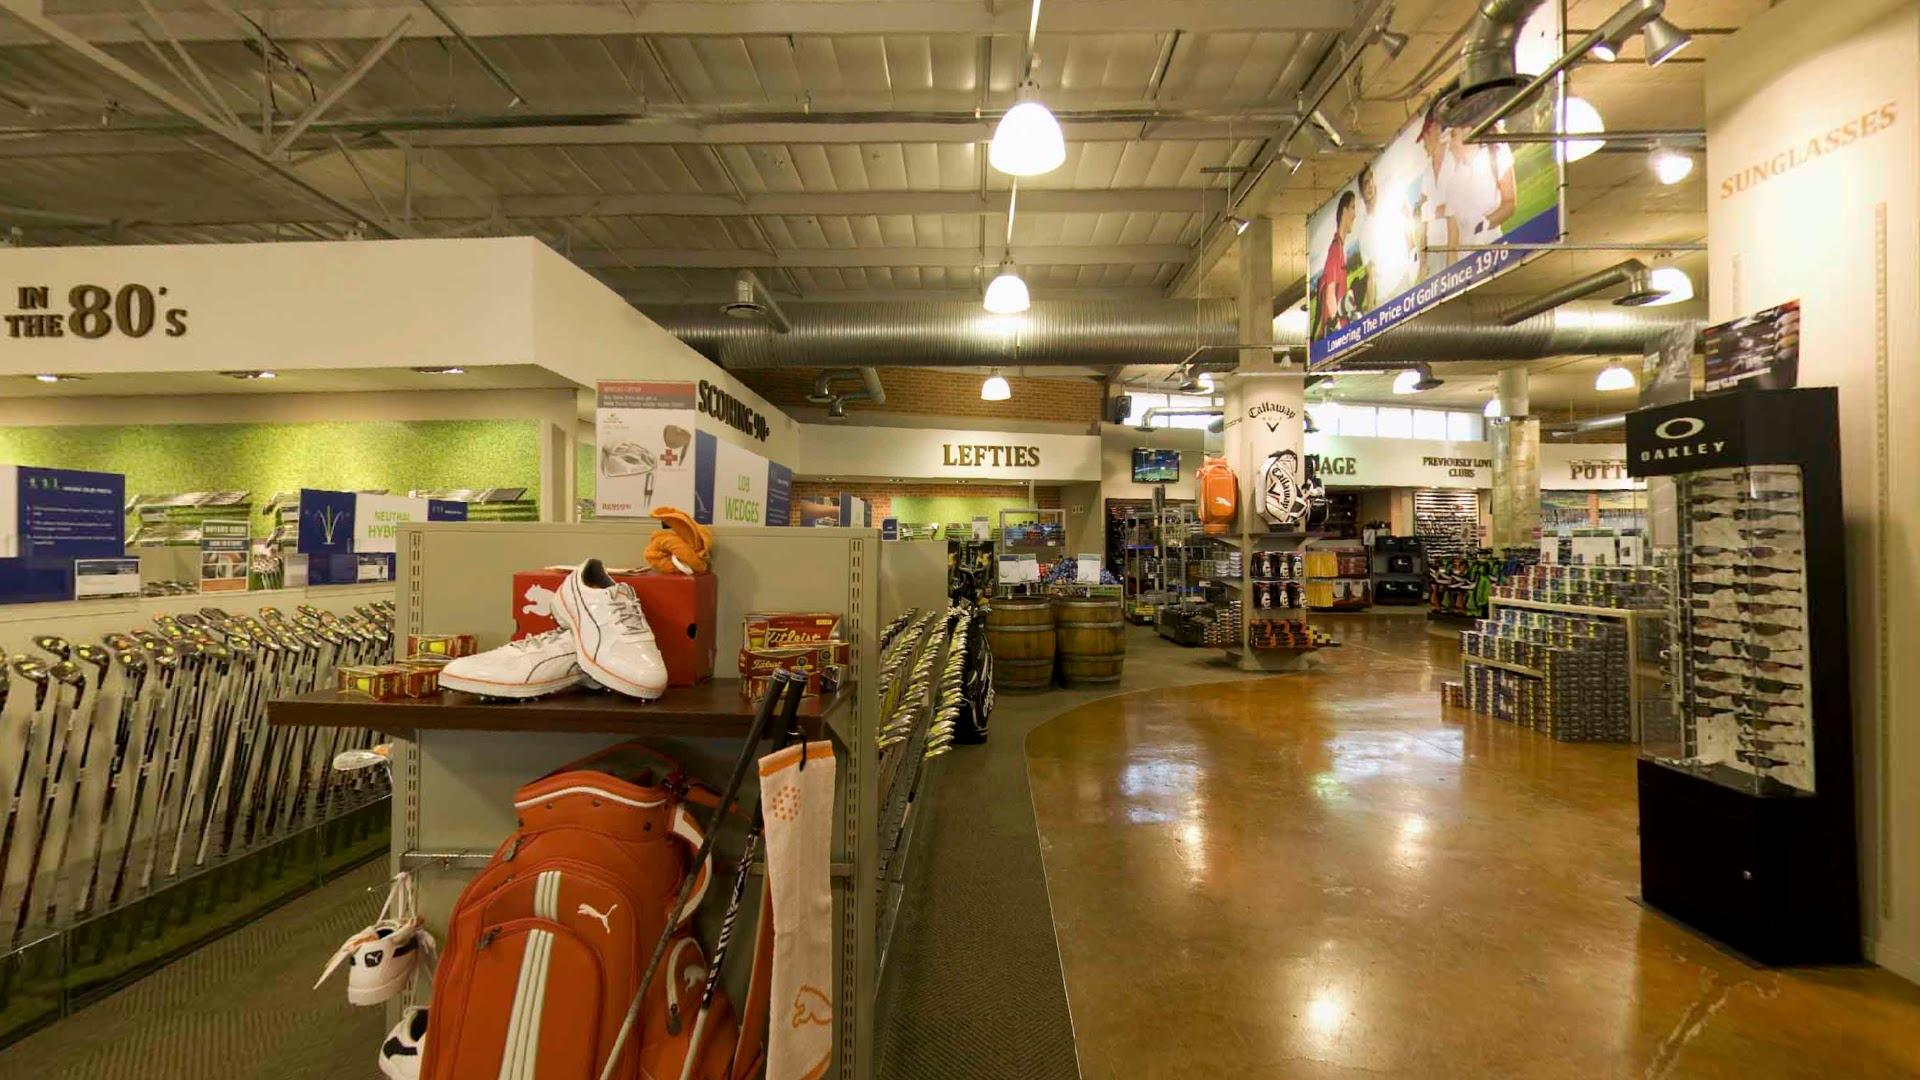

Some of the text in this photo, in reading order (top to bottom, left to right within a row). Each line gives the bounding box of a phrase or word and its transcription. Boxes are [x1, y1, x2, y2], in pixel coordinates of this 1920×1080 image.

[1719, 102, 1897, 200] SUNGLASSES
[18, 286, 49, 310] IN
[1327, 241, 1509, 353] Lowering The Price Of Golf Since 1976
[4, 314, 64, 338] THE
[698, 379, 753, 436] SCORING
[1248, 401, 1297, 420] Callaway
[943, 444, 1041, 467] LEFTIES
[1422, 456, 1472, 468] PREVIOUSLY
[1641, 441, 1725, 462] OAKLEY
[1448, 468, 1476, 478] CLUBS
[1570, 462, 1627, 480] PUTT
[1272, 467, 1292, 508] Callaway
[725, 496, 759, 523] WEDGES
[368, 525, 397, 538] HYBR
[767, 627, 821, 643] Titleist
